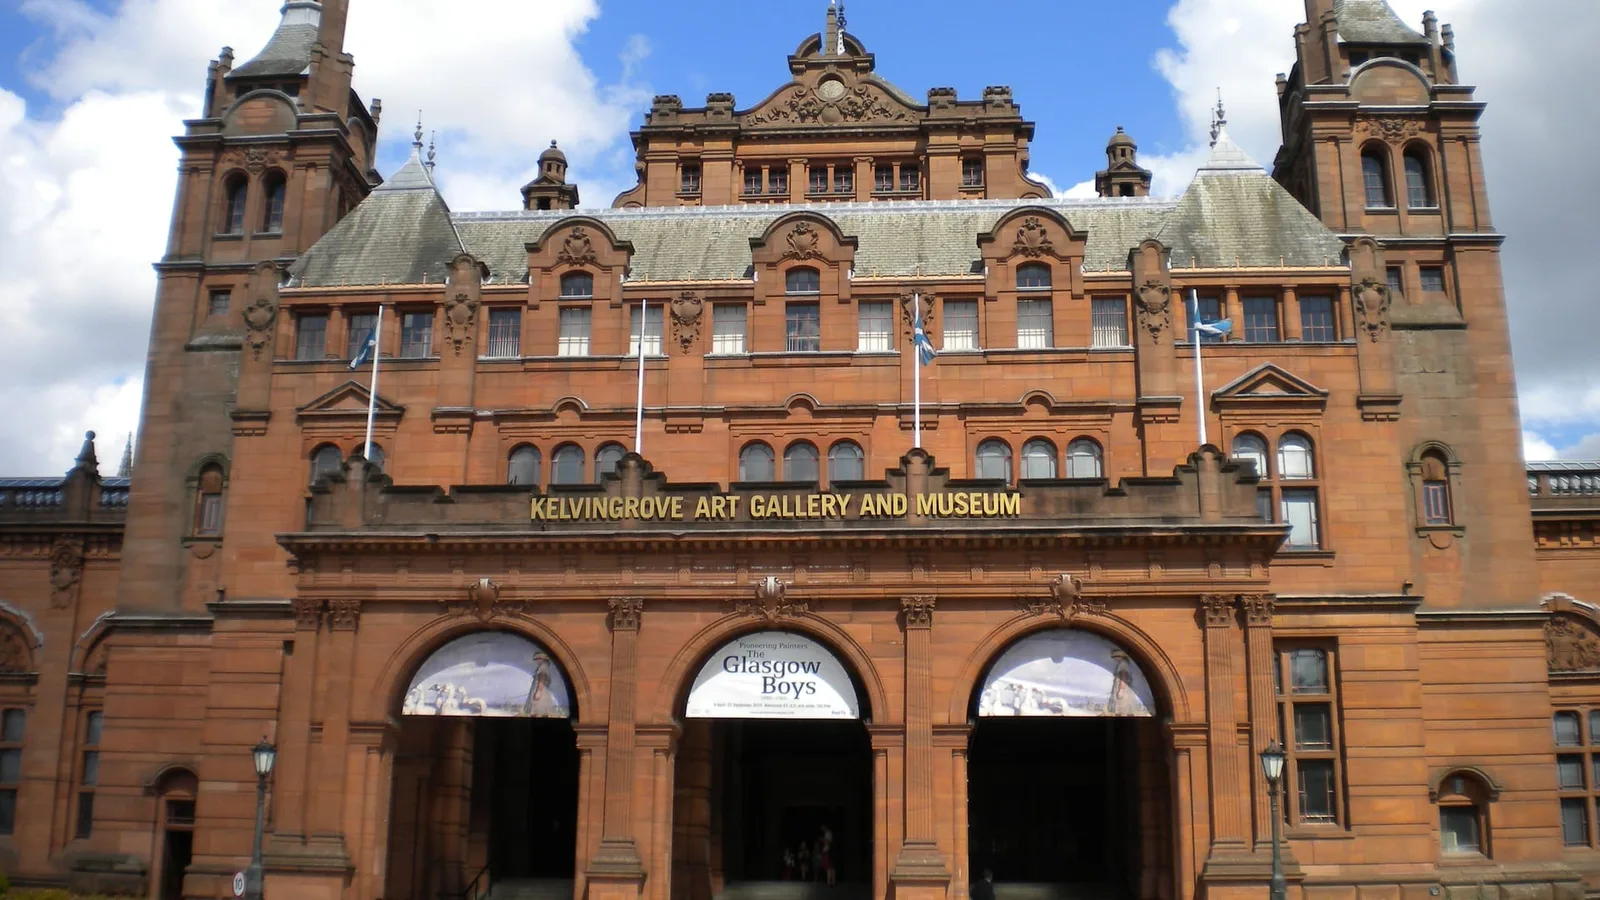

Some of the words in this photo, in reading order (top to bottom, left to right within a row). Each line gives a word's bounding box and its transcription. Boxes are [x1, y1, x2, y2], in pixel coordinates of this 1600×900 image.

[530, 496, 684, 520] KELVINGROVE
[694, 495, 741, 519] ART
[750, 493, 852, 518] GALLERY
[859, 493, 908, 517] AND
[916, 491, 1021, 516] MUSEUM
[739, 642, 777, 650] Pioneering
[779, 642, 808, 650] Painters
[746, 650, 765, 658] The
[723, 655, 822, 679] Glasgow
[761, 676, 816, 700] Boys
[235, 878, 243, 891] 10
